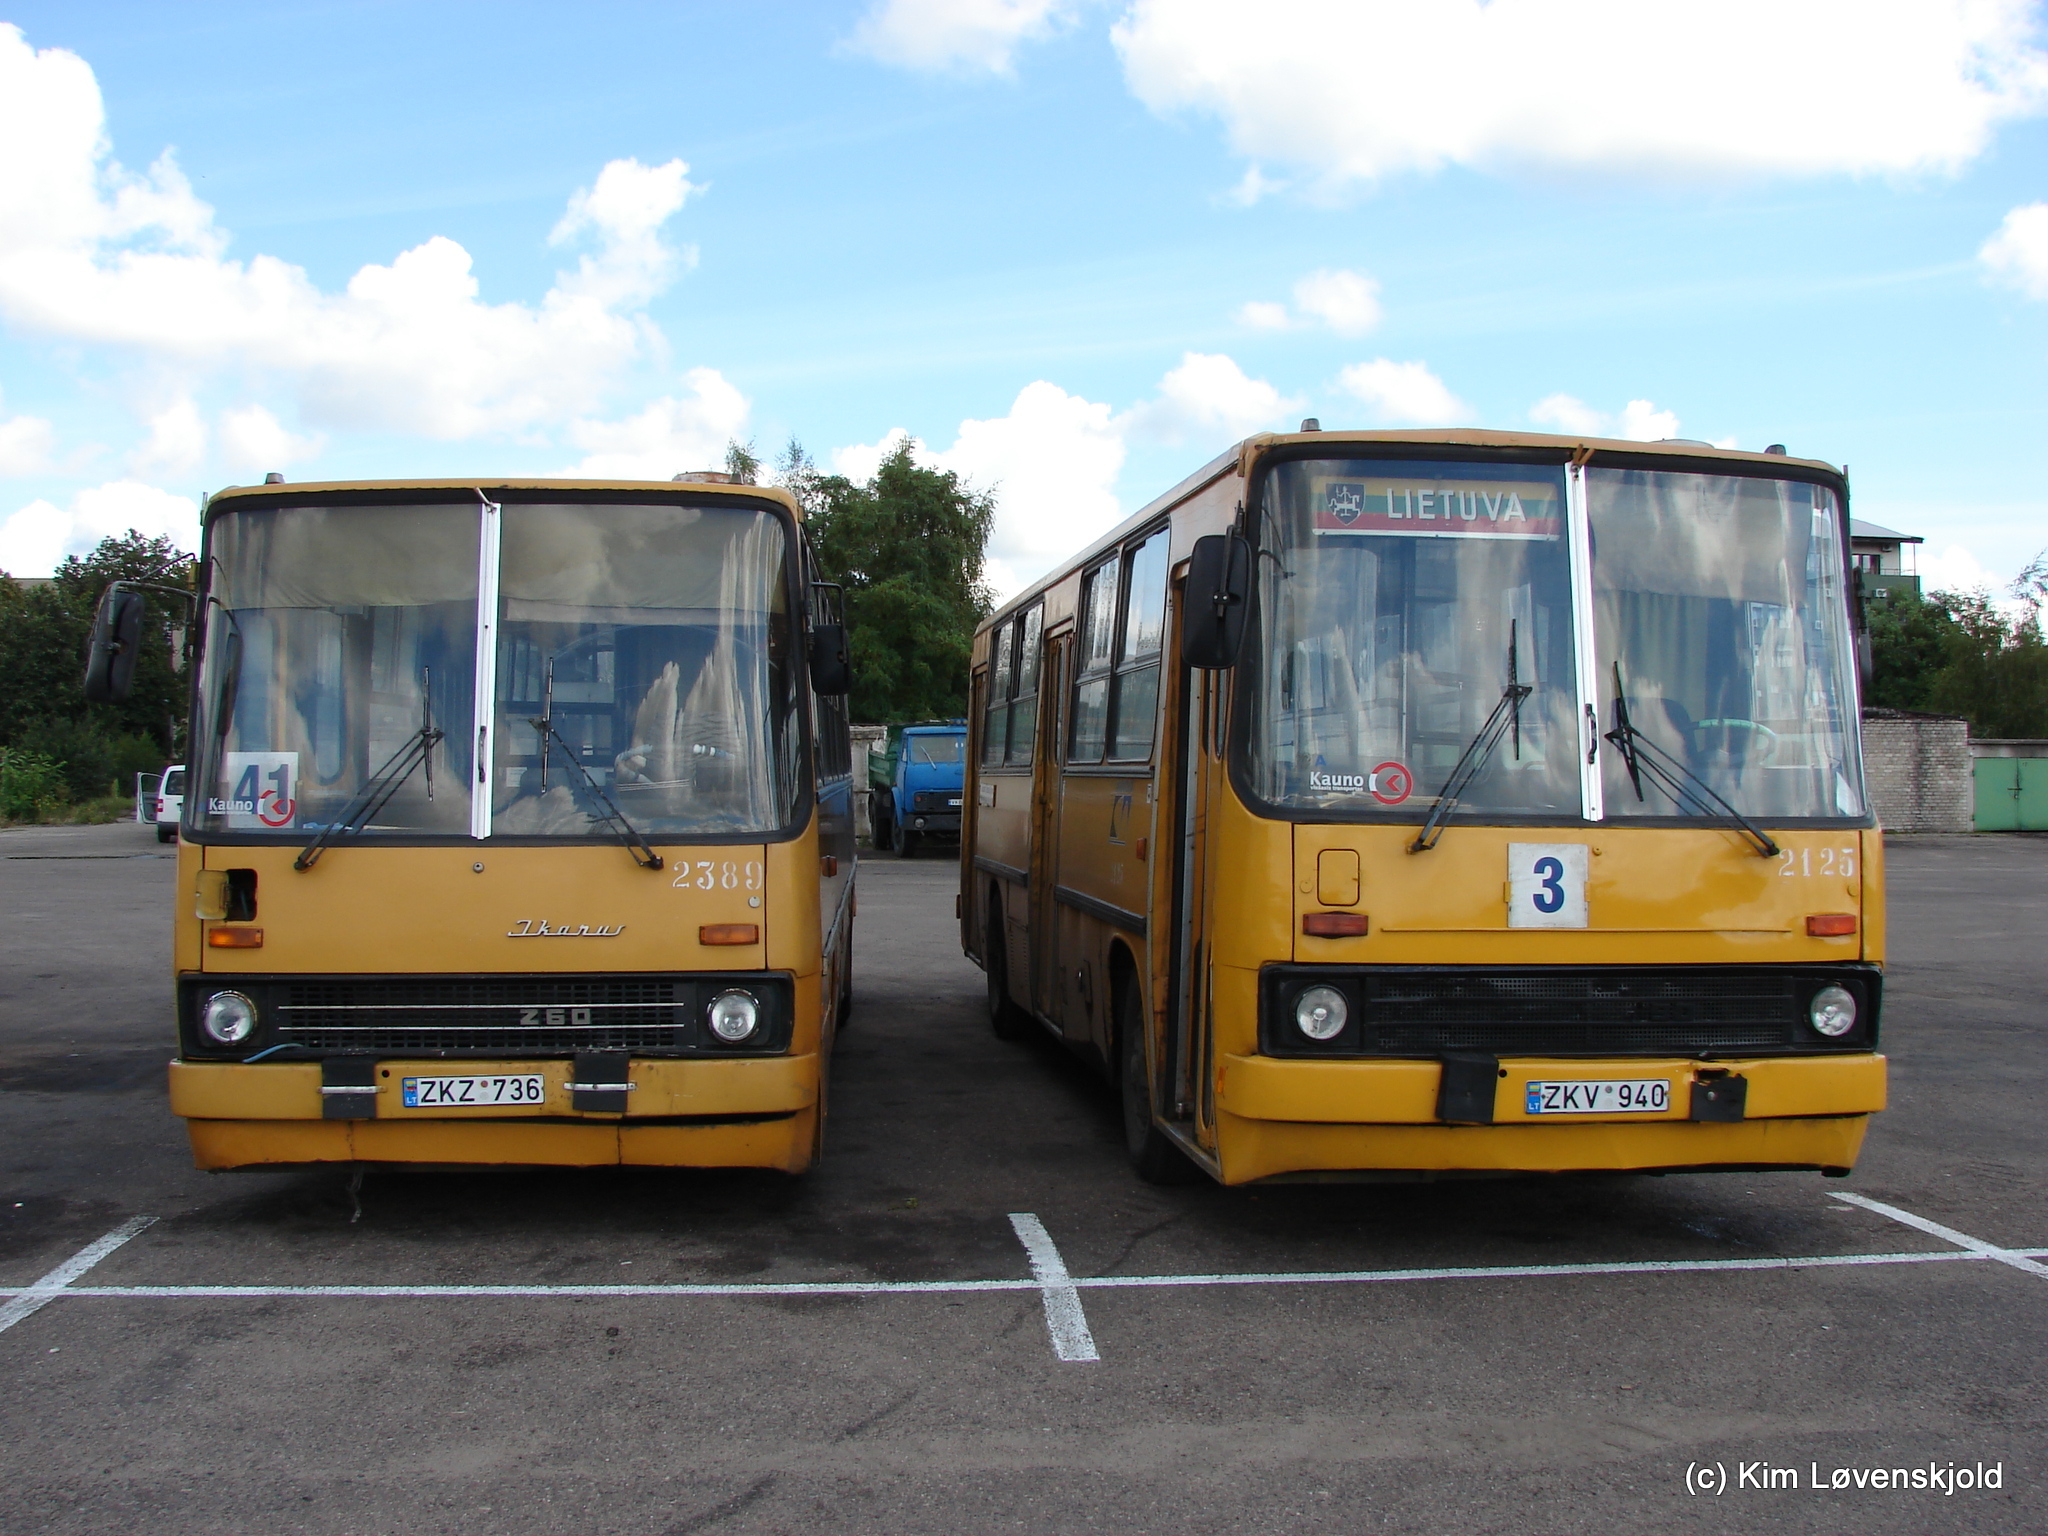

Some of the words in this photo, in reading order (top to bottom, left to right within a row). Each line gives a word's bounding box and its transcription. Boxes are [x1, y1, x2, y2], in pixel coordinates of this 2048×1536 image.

[1386, 487, 1527, 523] LIETUVA
[233, 763, 289, 815] 41
[1309, 771, 1364, 787] Kauno
[208, 797, 254, 811] Kauno
[1778, 848, 1854, 877] 2125
[672, 861, 763, 890] 2389
[1532, 856, 1565, 914] 3
[507, 919, 627, 937] Ikarus
[406, 1096, 418, 1105] LT
[420, 1080, 476, 1103] ZKZ
[493, 1078, 540, 1101] 736
[1543, 1085, 1600, 1109] ZKV
[1618, 1083, 1665, 1108] 940
[1528, 1102, 1540, 1111] LT
